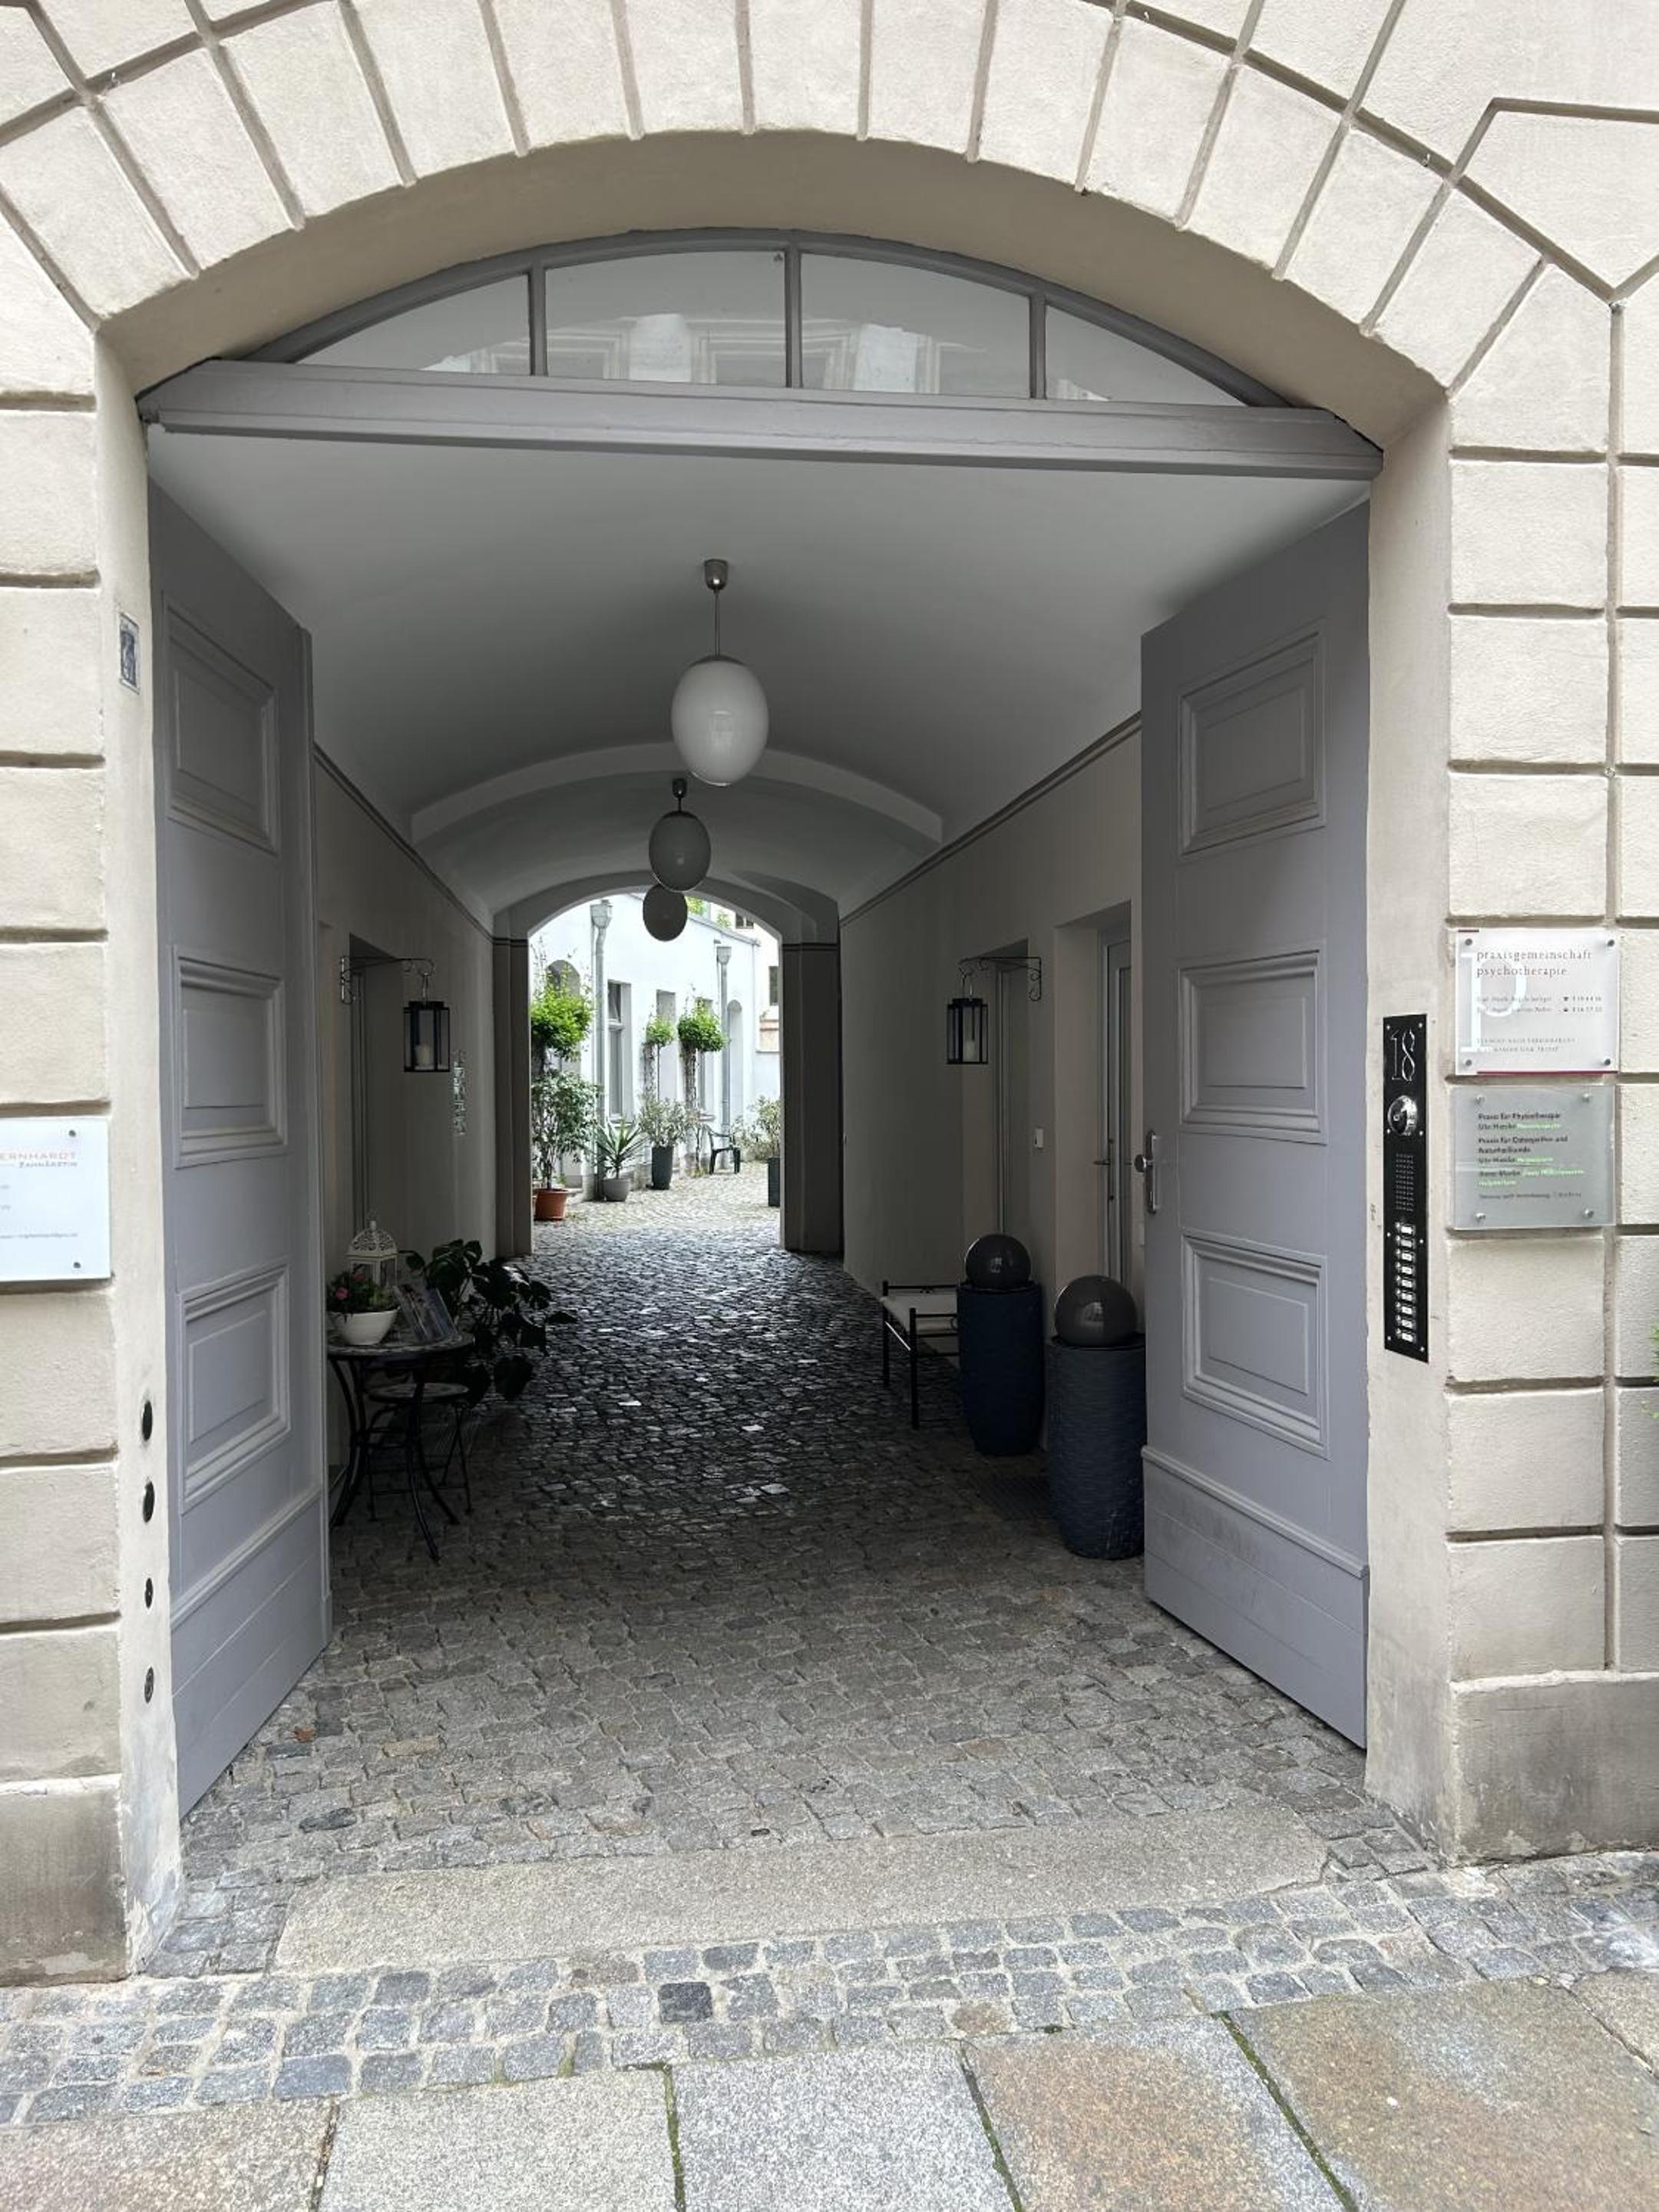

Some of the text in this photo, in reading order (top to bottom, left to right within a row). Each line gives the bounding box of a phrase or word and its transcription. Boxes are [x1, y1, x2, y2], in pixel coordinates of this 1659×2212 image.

[1476, 950, 1591, 962] praxisgemeinschaft
[1476, 965, 1568, 978] psychotherapie
[1390, 1028, 1416, 1082] 18
